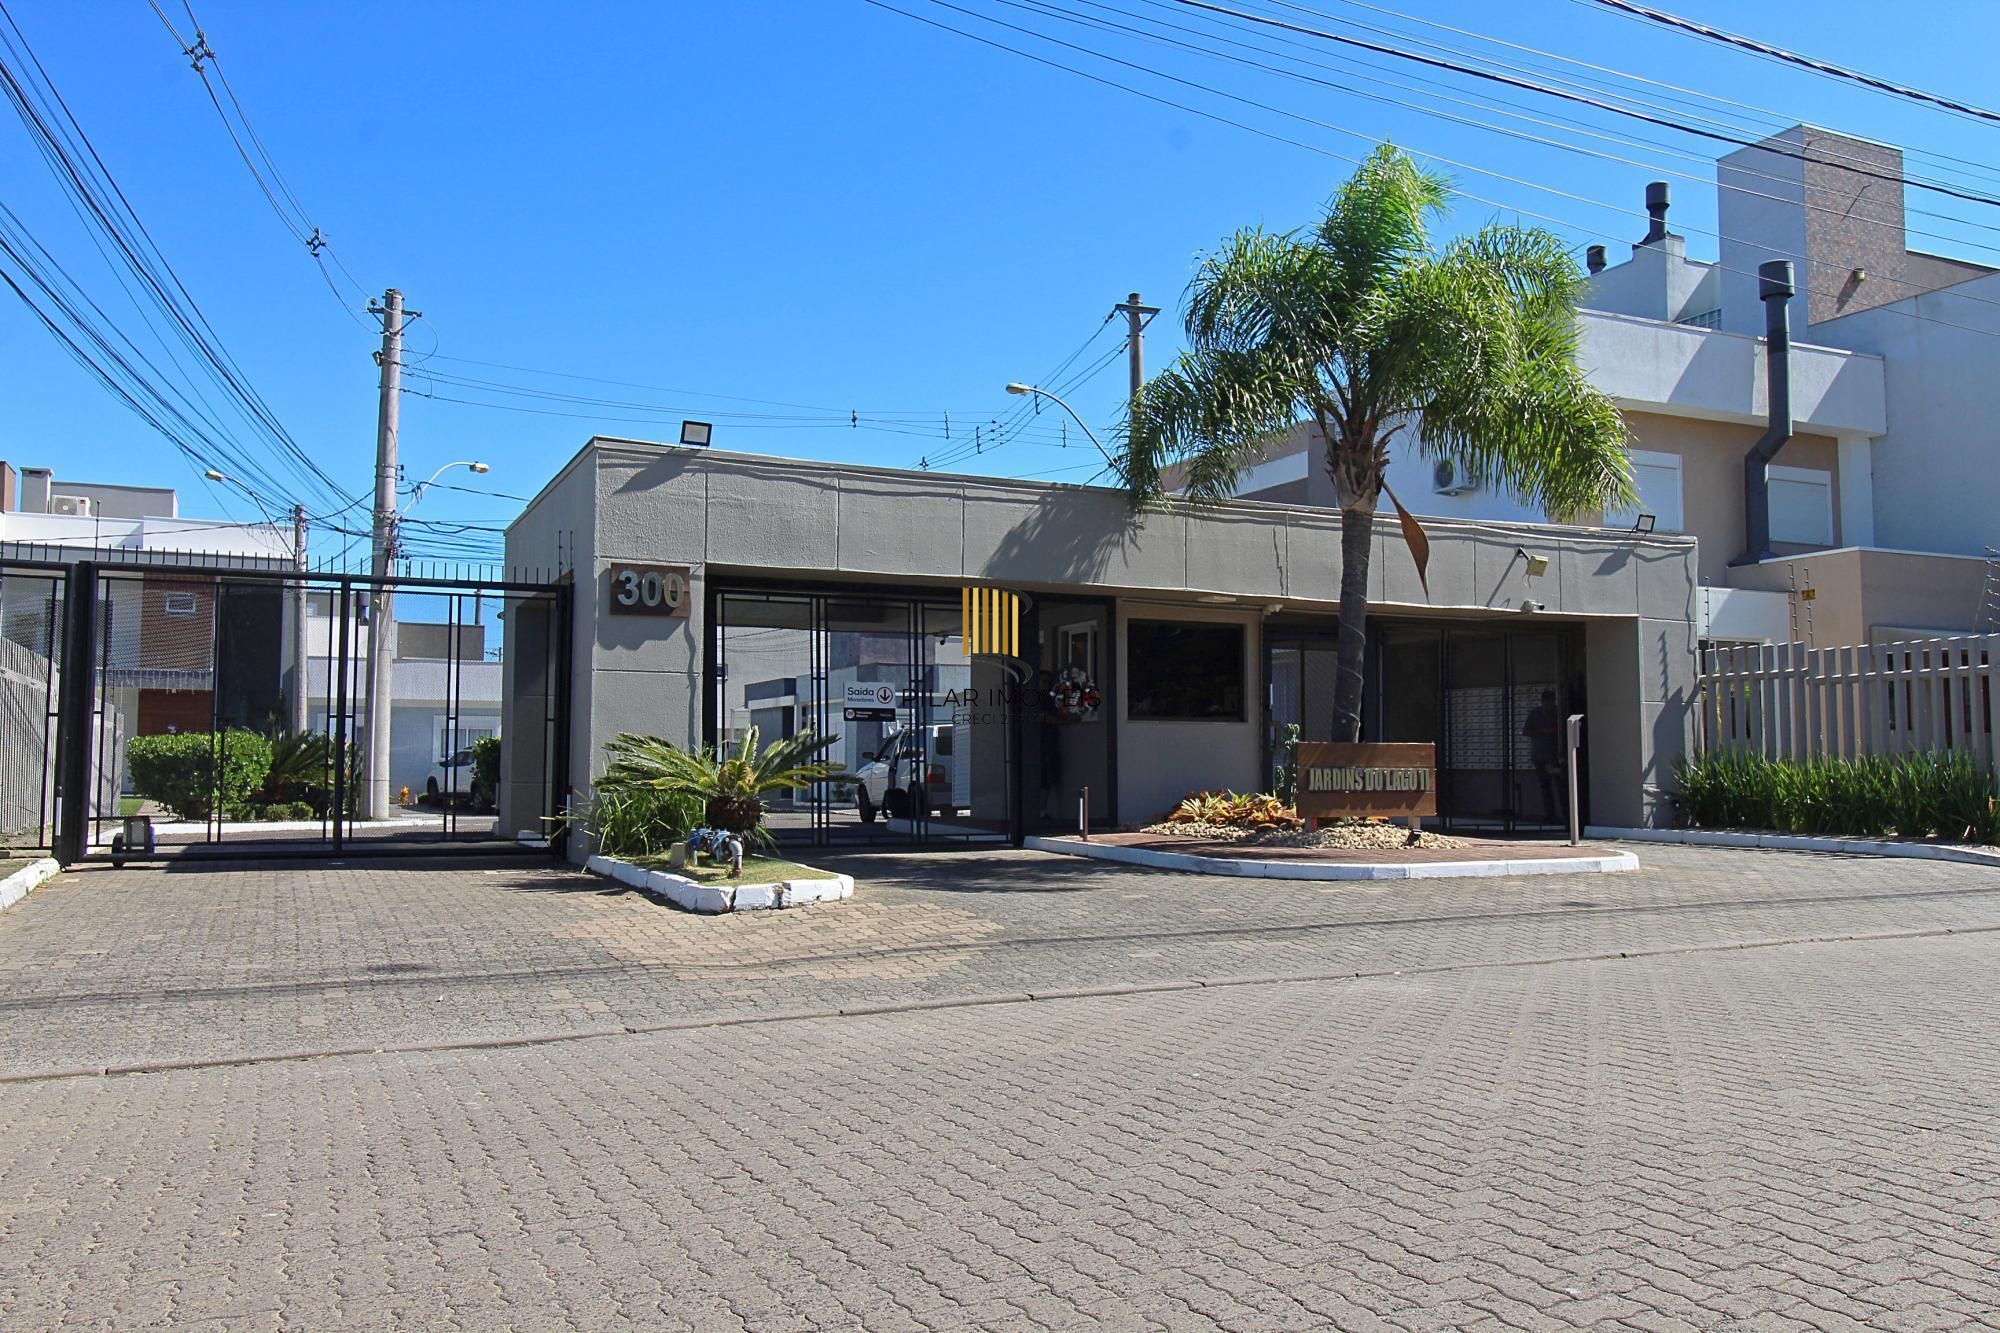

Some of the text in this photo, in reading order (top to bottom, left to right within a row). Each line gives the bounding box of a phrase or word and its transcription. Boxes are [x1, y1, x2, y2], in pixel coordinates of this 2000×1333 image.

[617, 570, 685, 608] 300
[1309, 768, 1363, 791] JARDINS
[1385, 768, 1417, 791] LAGO
